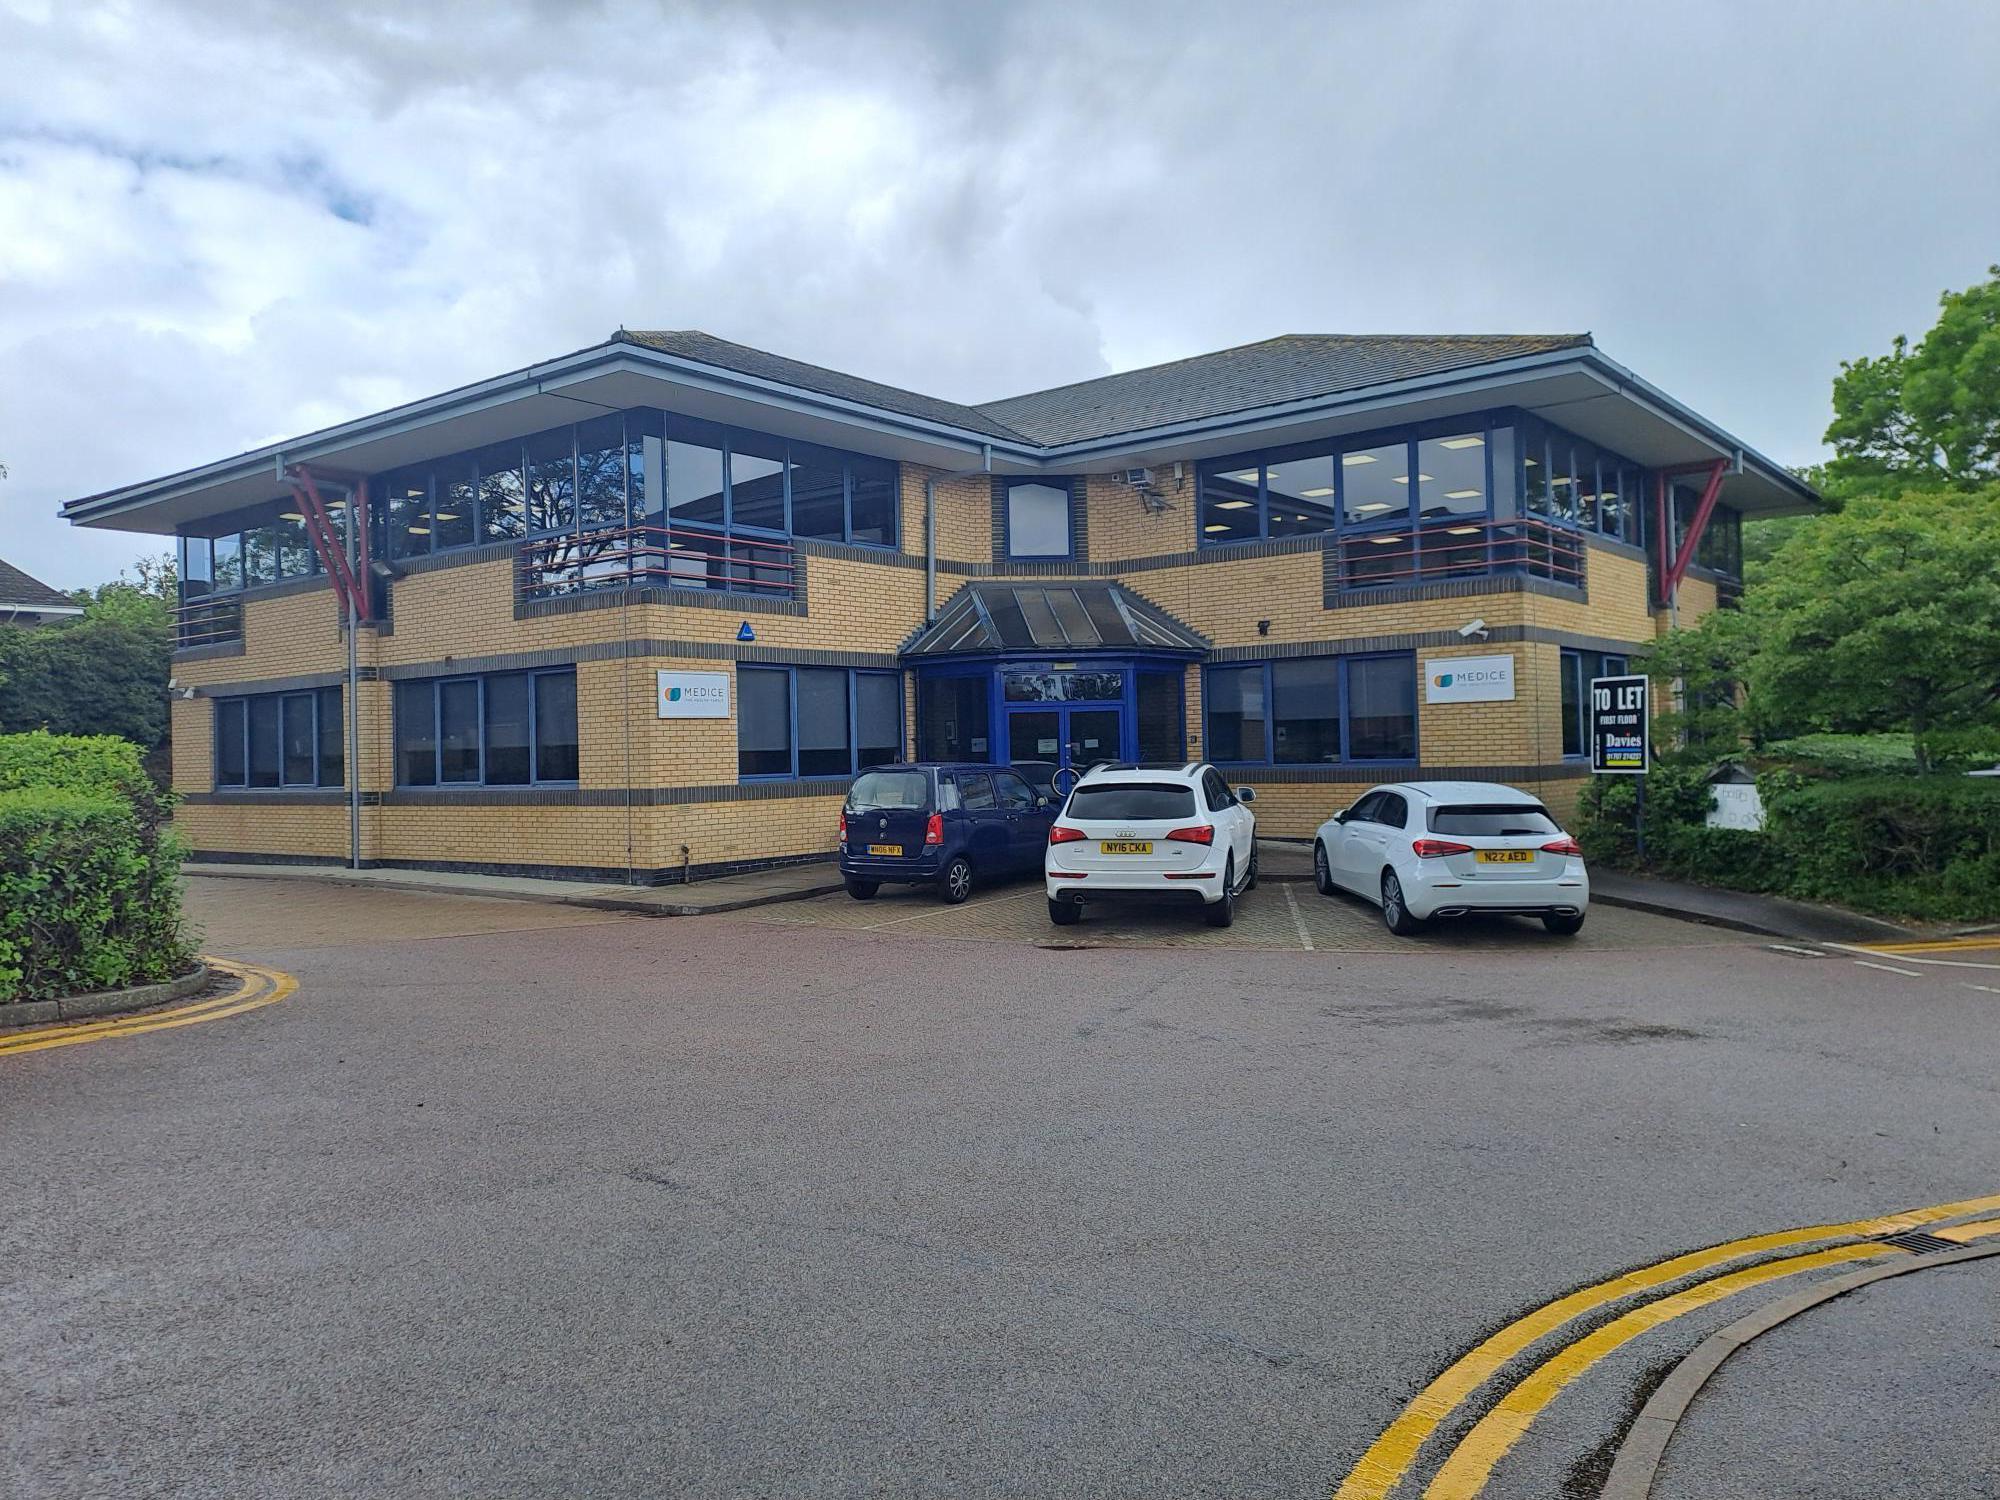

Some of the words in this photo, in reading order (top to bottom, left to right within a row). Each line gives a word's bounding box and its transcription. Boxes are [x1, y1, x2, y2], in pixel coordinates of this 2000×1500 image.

[1457, 670, 1506, 682] MEDICE
[684, 687, 724, 697] MEDICE
[1594, 688, 1611, 711] TO
[1617, 686, 1644, 710] LET
[1600, 715, 1616, 725] FIRST
[1617, 714, 1638, 725] FLOOR
[1606, 732, 1642, 748] Davies
[1106, 842, 1127, 853] NY16
[1129, 842, 1147, 853] CKA
[1484, 852, 1505, 862] N22
[1507, 851, 1527, 861] AED
